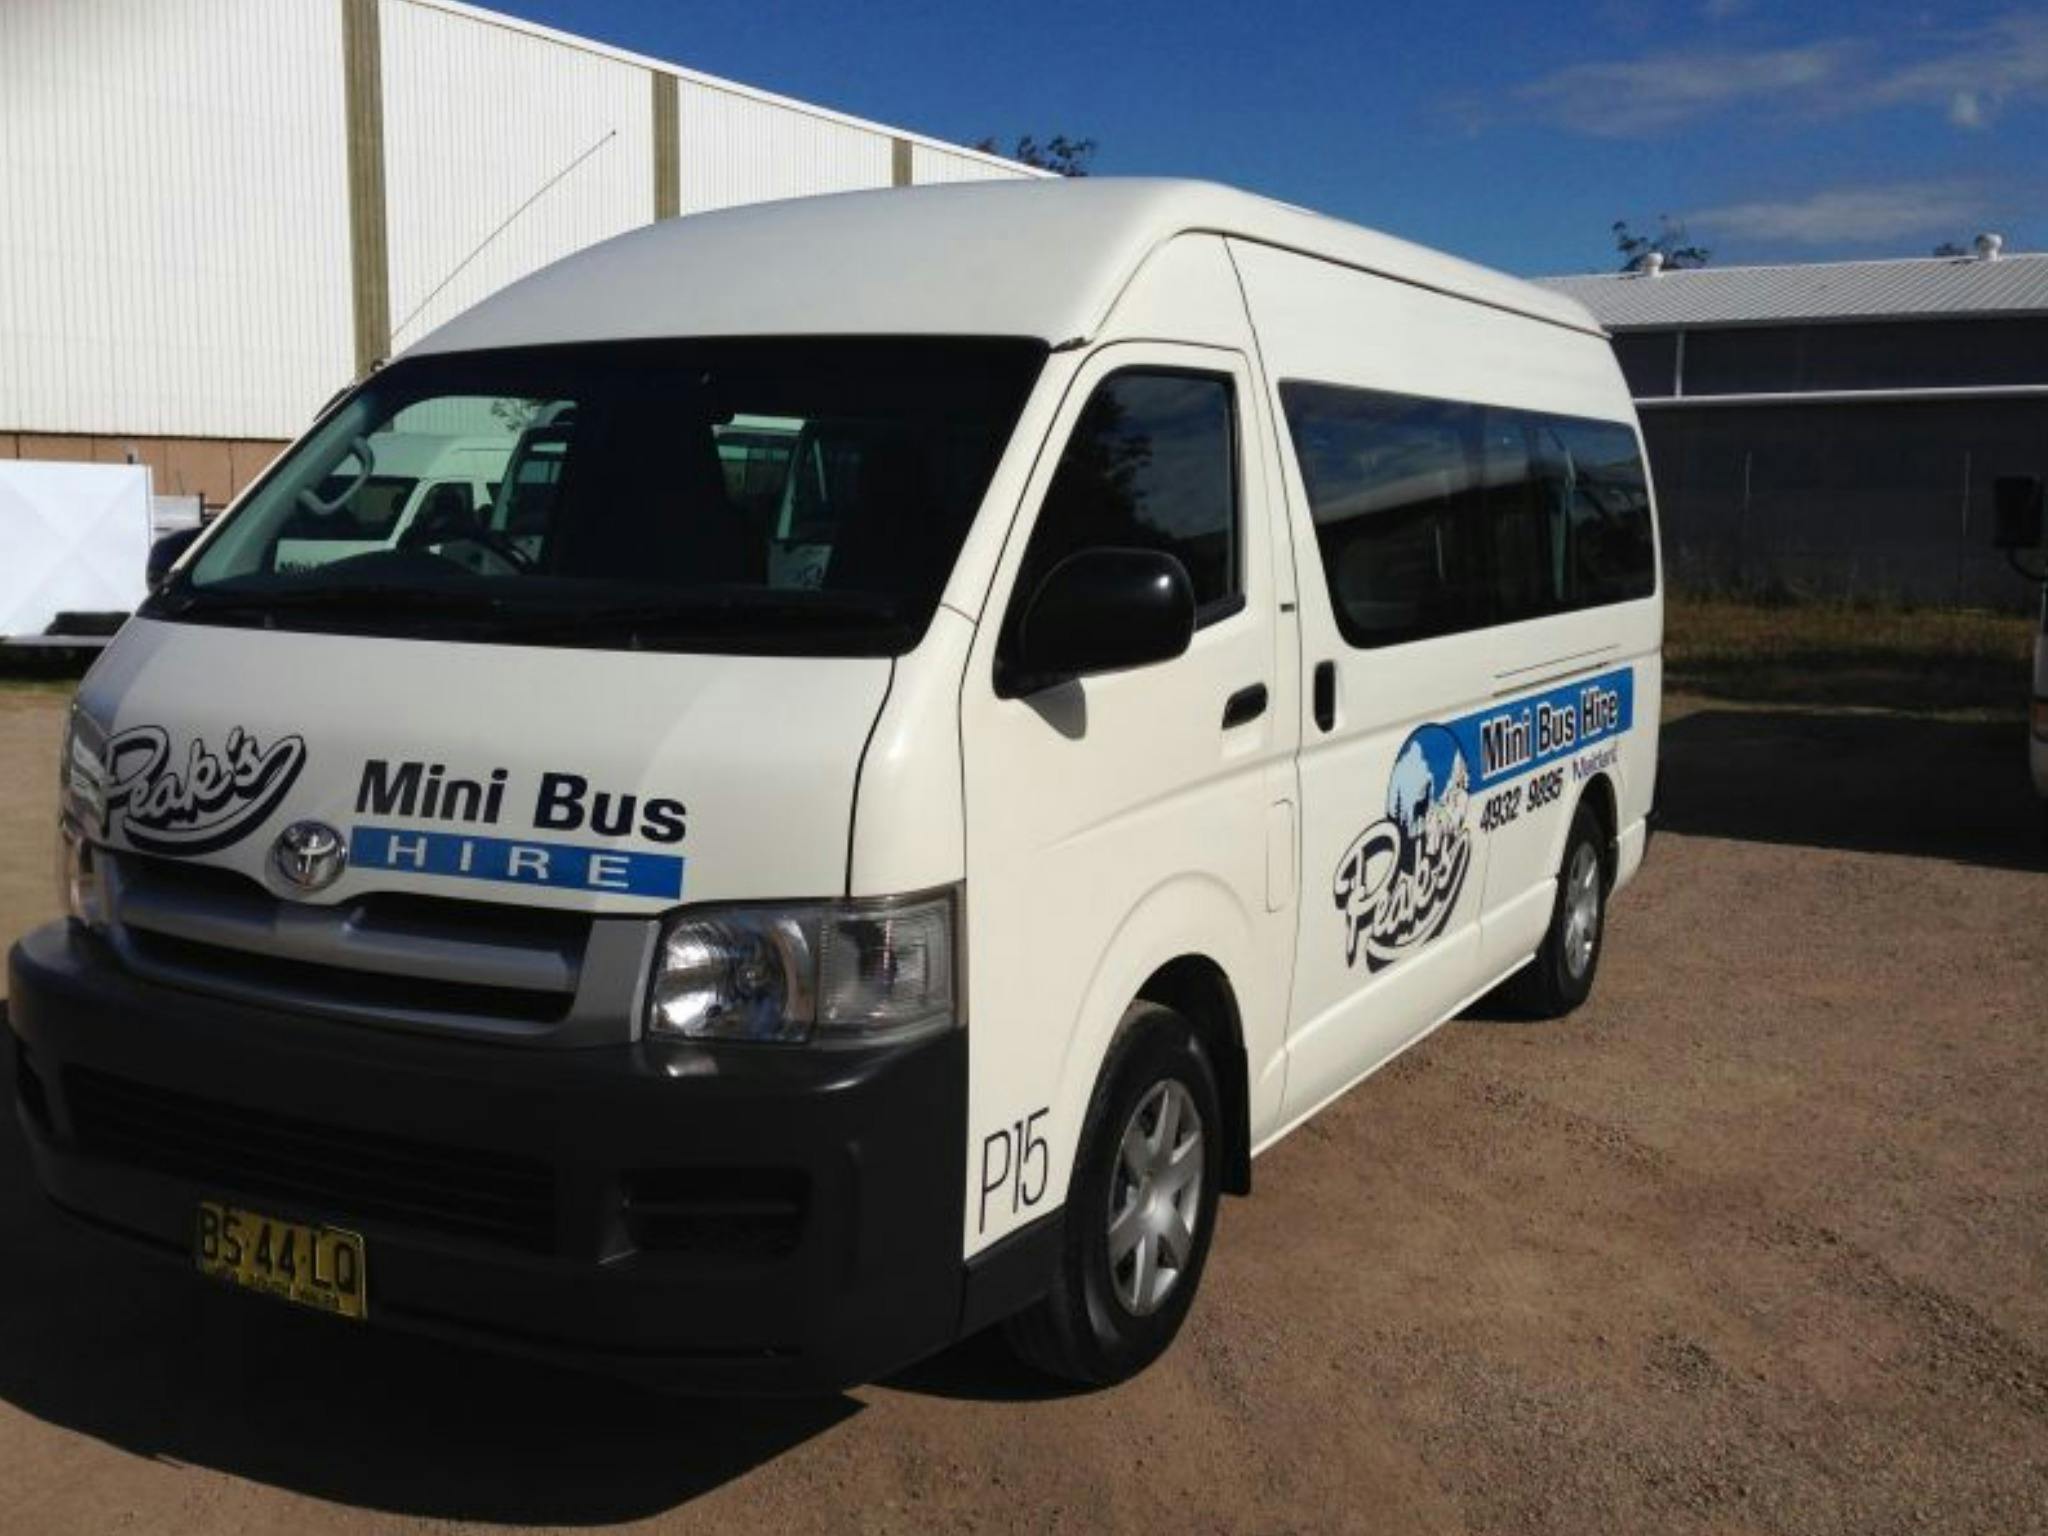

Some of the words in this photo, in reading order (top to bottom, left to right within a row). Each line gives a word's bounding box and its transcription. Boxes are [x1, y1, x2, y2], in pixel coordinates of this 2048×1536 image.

[1480, 707, 1532, 781] Mini
[1537, 701, 1576, 757] Bus
[1580, 686, 1617, 739] Hire
[102, 725, 306, 858] Peak's
[354, 759, 509, 824] Mini
[532, 771, 687, 844] Bus
[1479, 785, 1522, 832] 4932
[387, 834, 631, 888] HIRE
[979, 1106, 1050, 1235] P15
